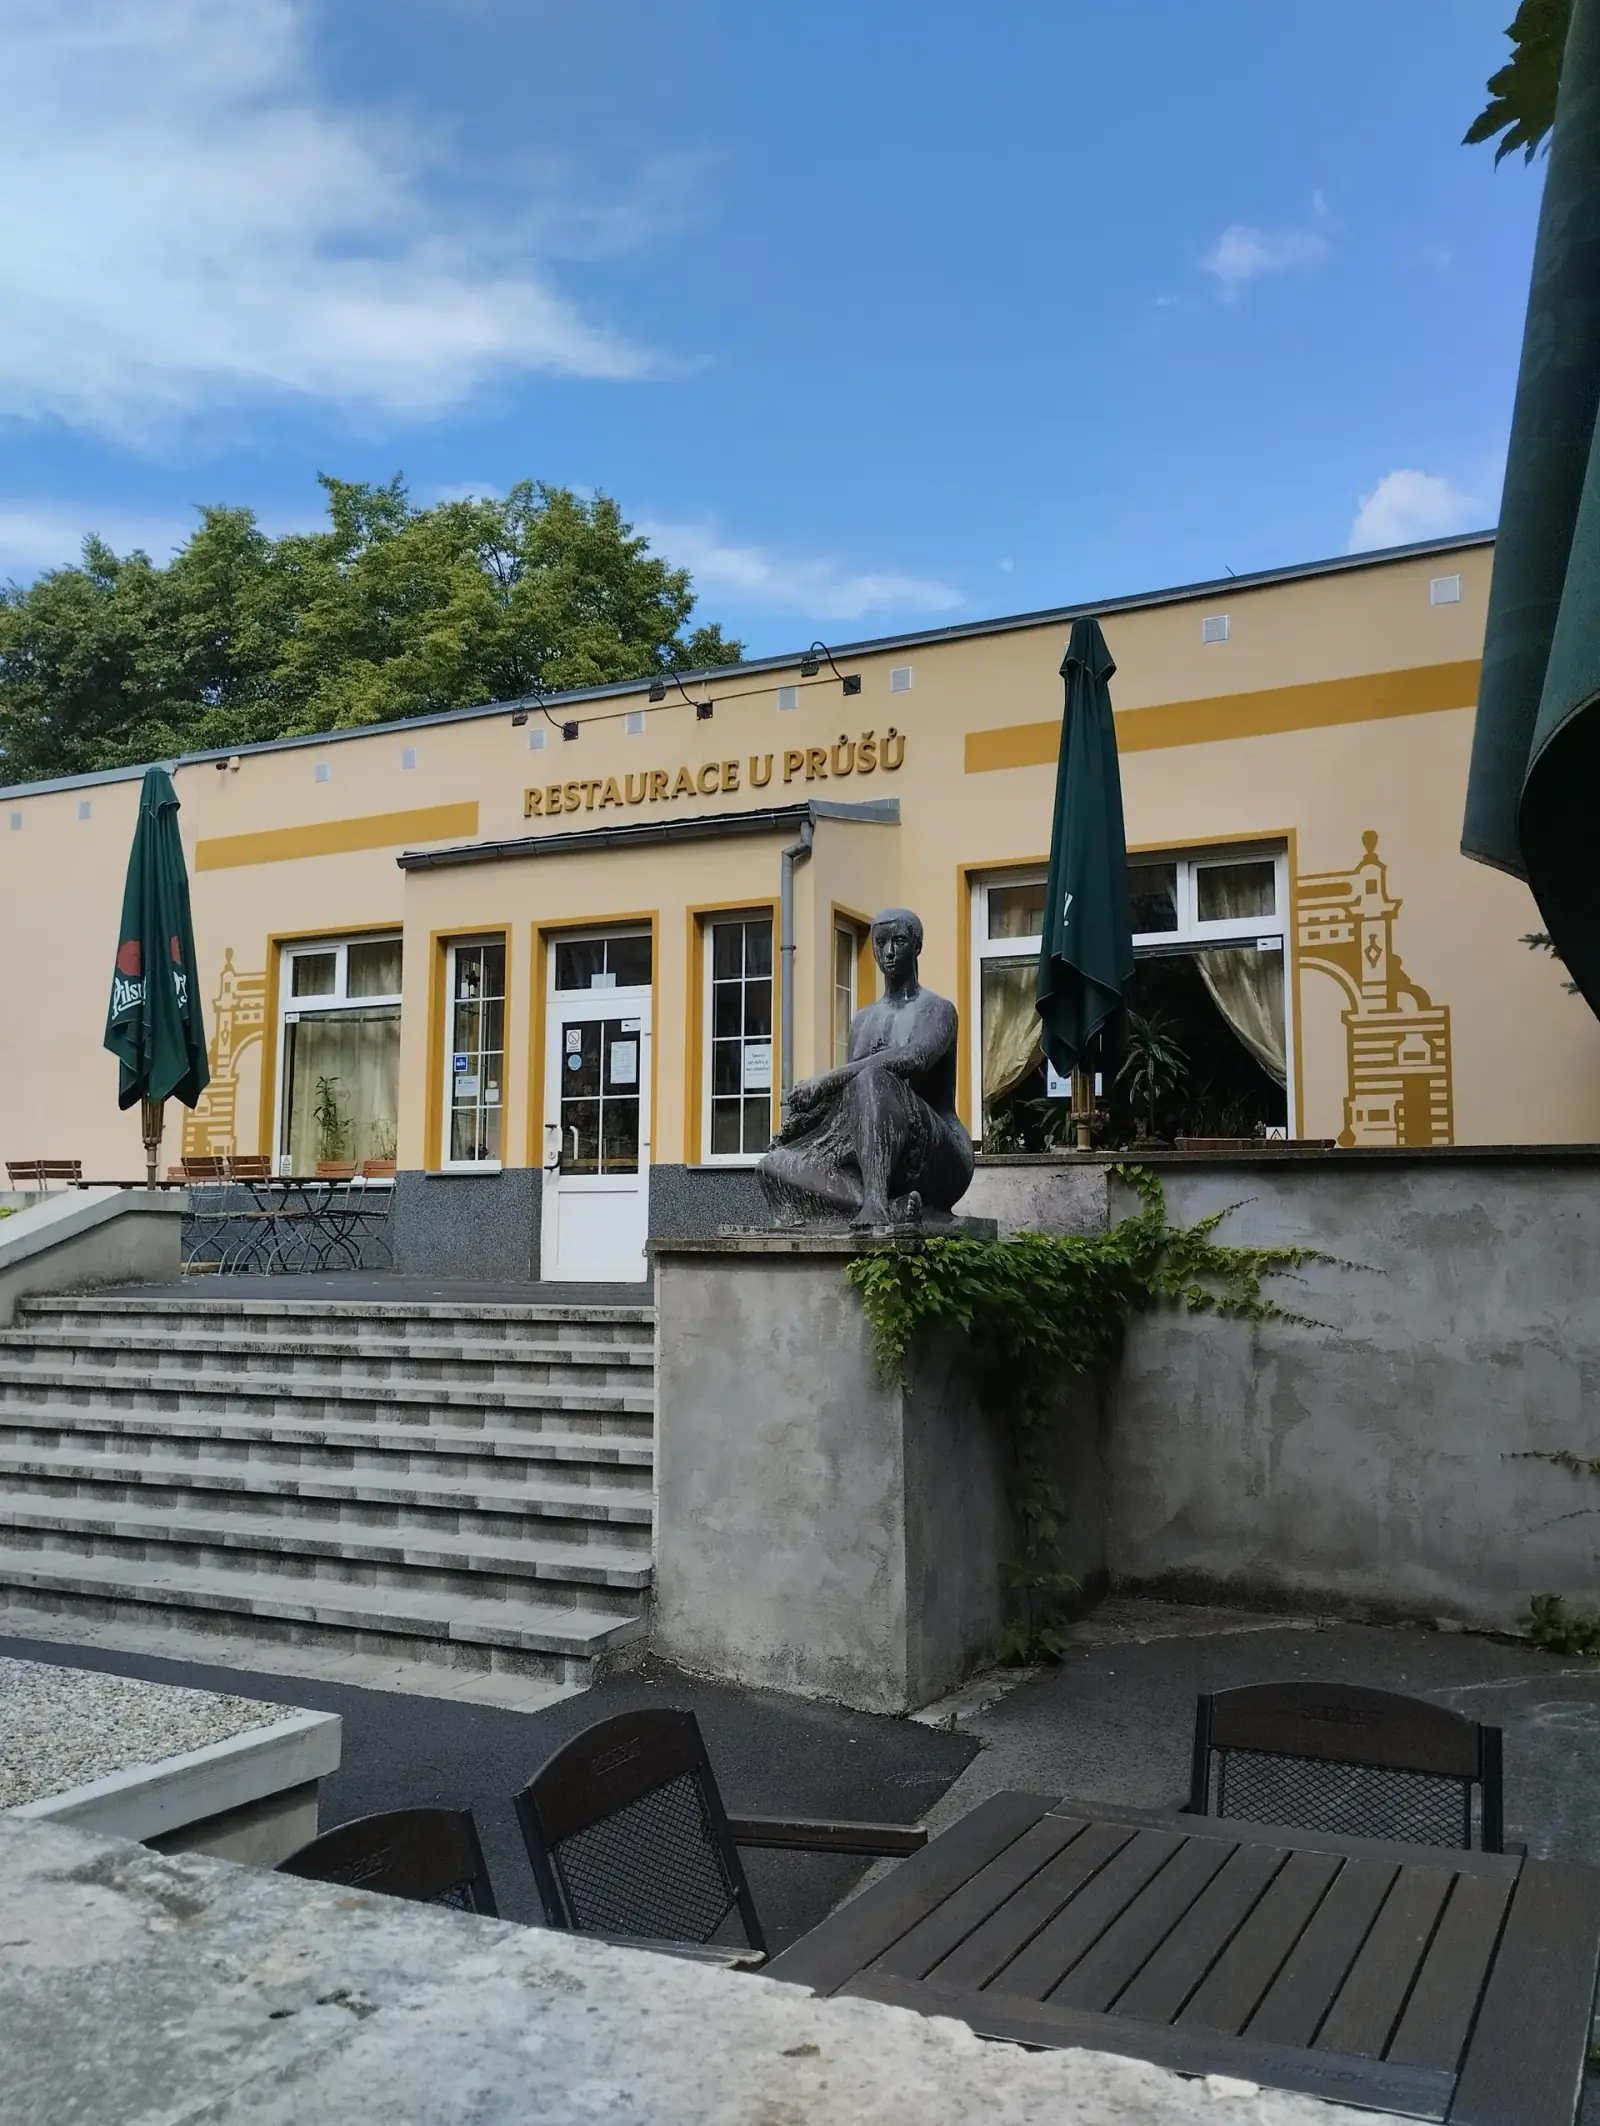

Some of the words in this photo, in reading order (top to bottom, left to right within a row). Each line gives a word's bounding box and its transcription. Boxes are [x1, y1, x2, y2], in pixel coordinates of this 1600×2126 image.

[523, 759, 740, 818] RESTAURACE
[748, 754, 774, 788] U
[783, 726, 907, 783] PRŮŠŮ
